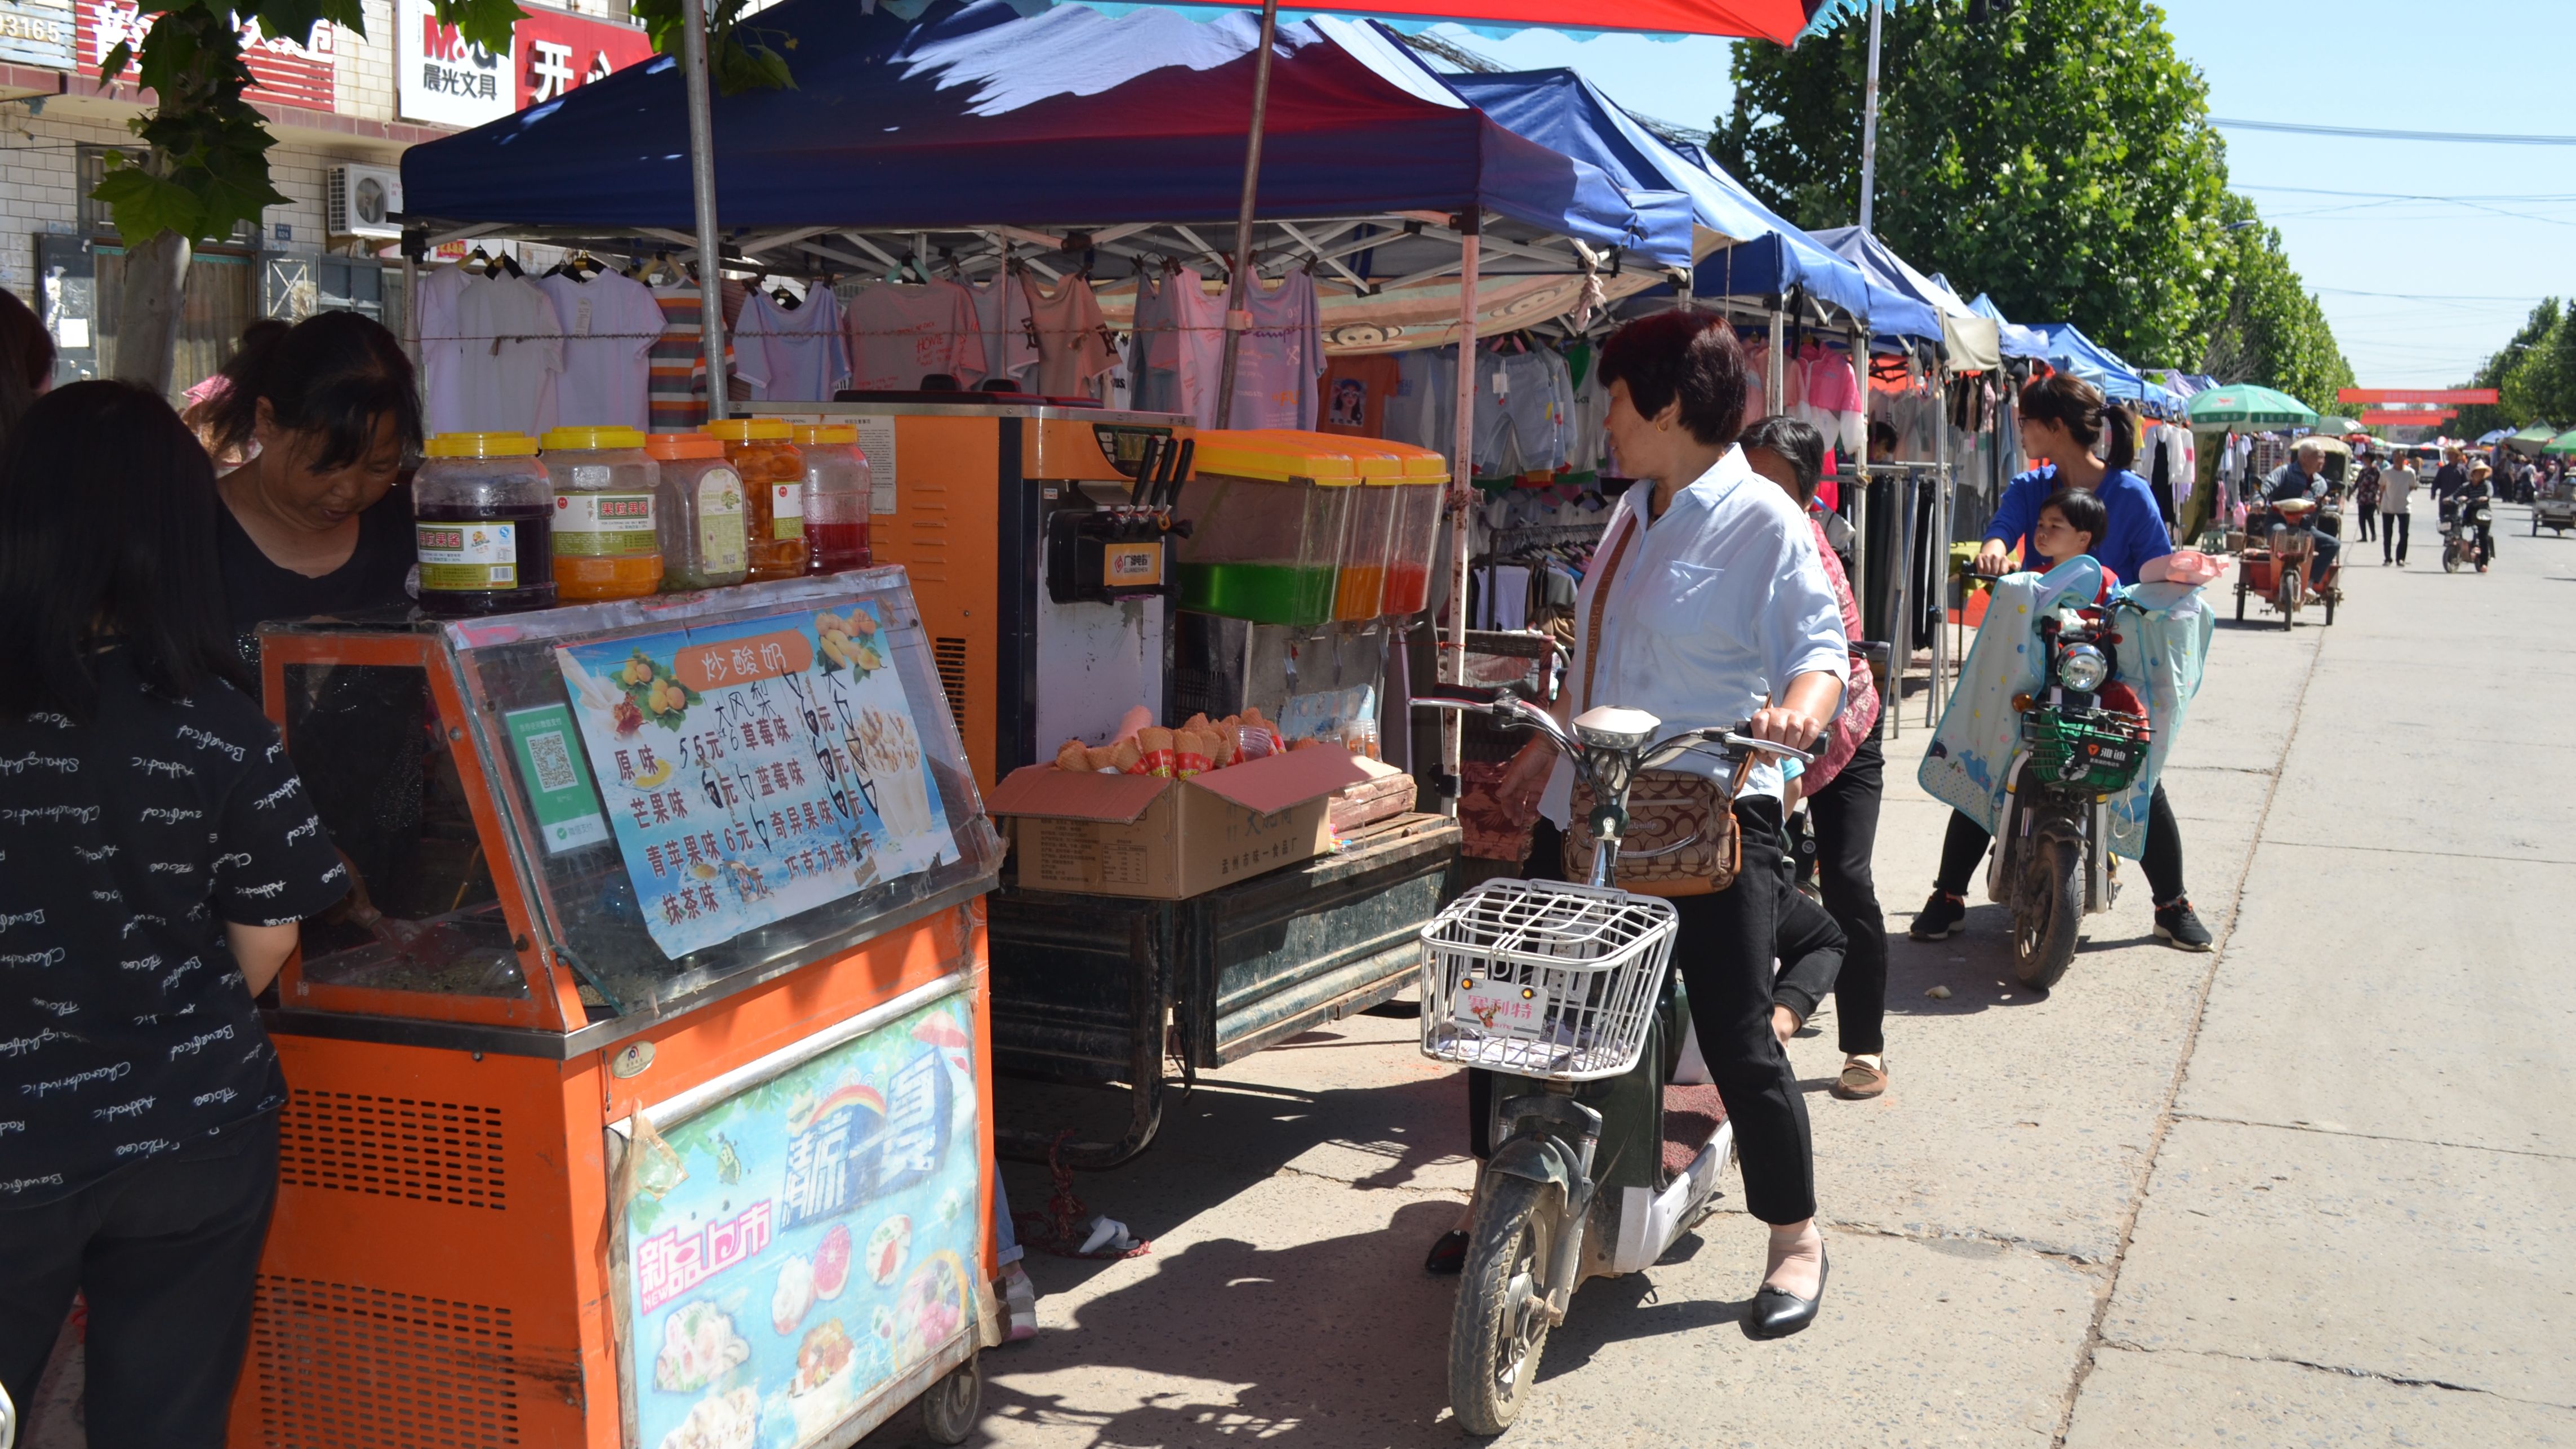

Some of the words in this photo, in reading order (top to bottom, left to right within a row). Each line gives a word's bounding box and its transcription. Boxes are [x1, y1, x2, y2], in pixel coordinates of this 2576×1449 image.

[0, 14, 60, 43] 3165
[423, 63, 497, 101] 晨光文具
[600, 501, 648, 516] 果粒果酱
[701, 642, 788, 682] 炒酸奶
[740, 714, 794, 751] 草莓味
[613, 744, 660, 782] 原味
[2099, 748, 2126, 761] 雅迪
[754, 757, 807, 797] 蓝莓味
[629, 788, 689, 829] 芒果味
[769, 797, 835, 839] 奇异果味
[646, 829, 722, 879] 青苹果味
[724, 821, 754, 853] 6元
[784, 840, 849, 881] 巧克力味
[1221, 837, 1298, 874] 孟州市味一食品厂
[661, 881, 720, 927] 抹茶味
[781, 1052, 937, 1221] 清凉一夏
[639, 1201, 771, 1295] 新品上市
[643, 1284, 669, 1312] NEW
